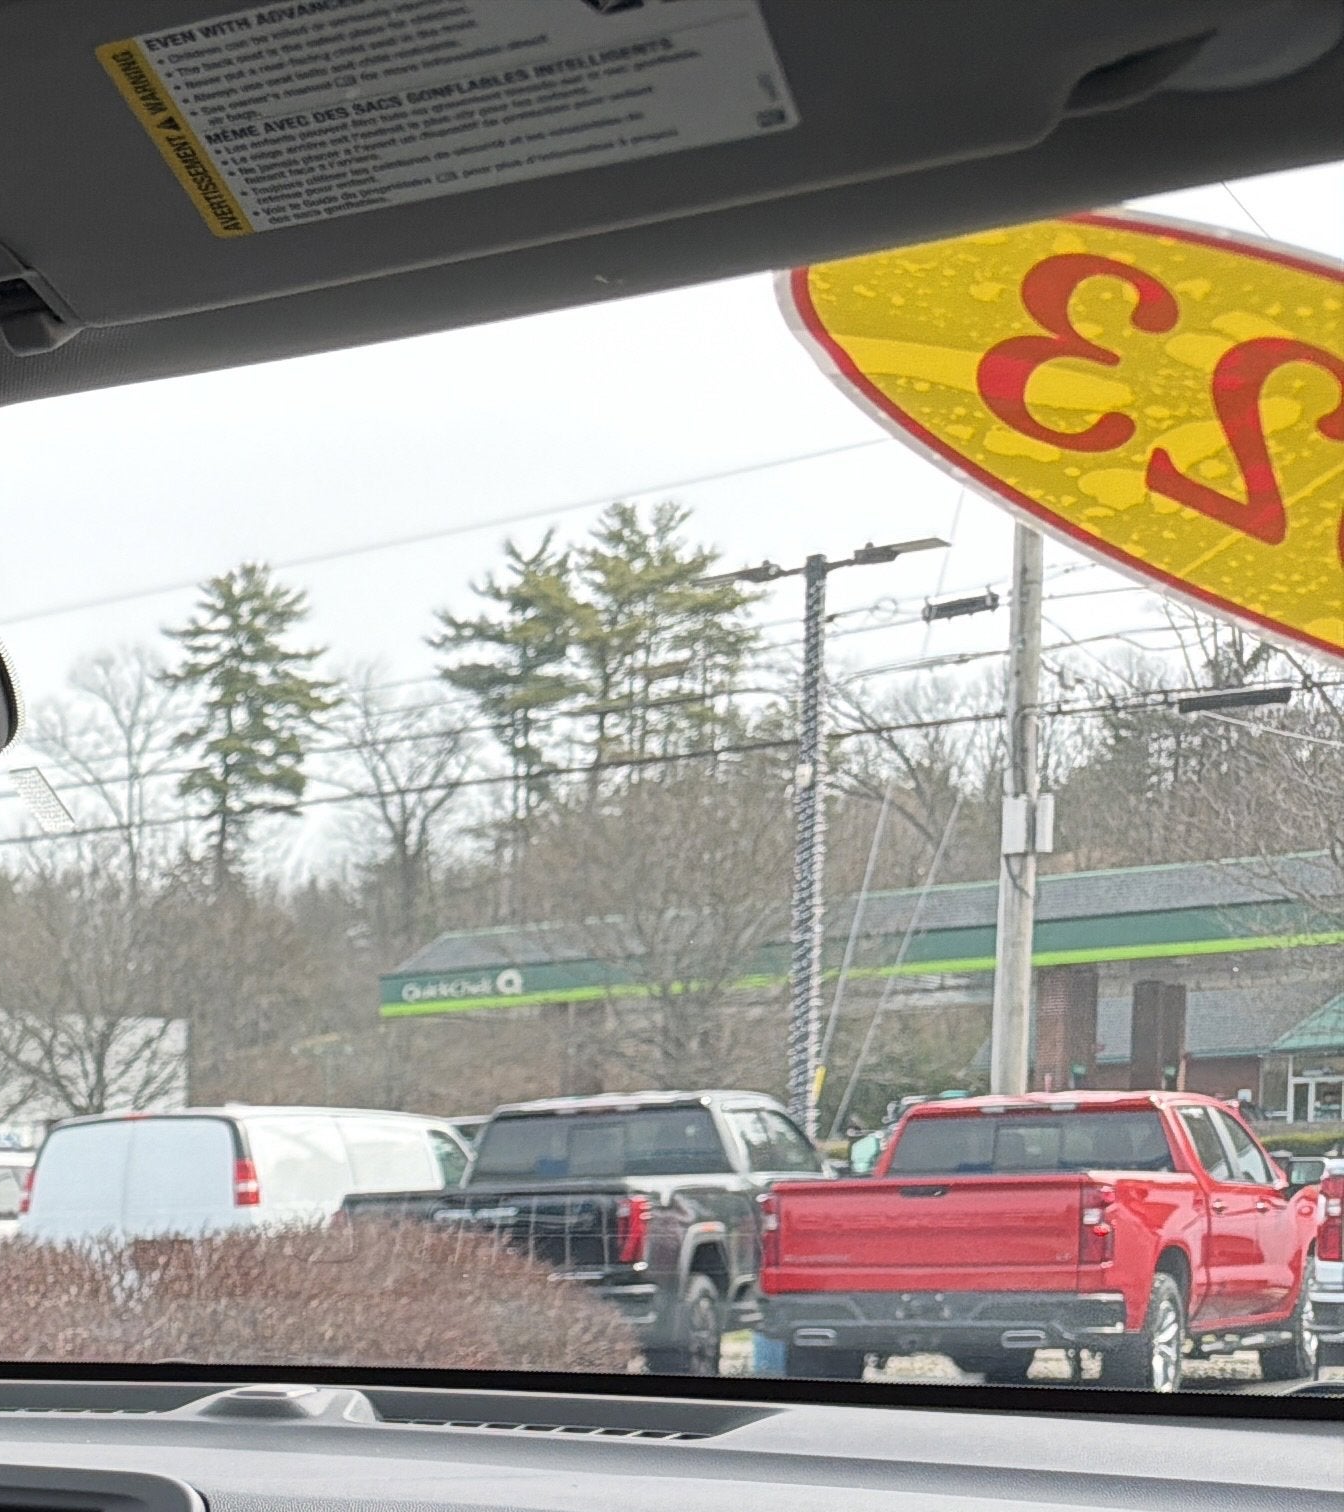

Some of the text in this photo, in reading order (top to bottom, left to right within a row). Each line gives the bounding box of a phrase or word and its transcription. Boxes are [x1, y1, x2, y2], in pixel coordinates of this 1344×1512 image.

[143, 30, 198, 50] EVEN
[197, 17, 253, 38] WITH
[112, 51, 168, 115] WARNING
[260, 114, 310, 135] AVEC
[311, 106, 350, 124] DES
[350, 94, 404, 116] SACS
